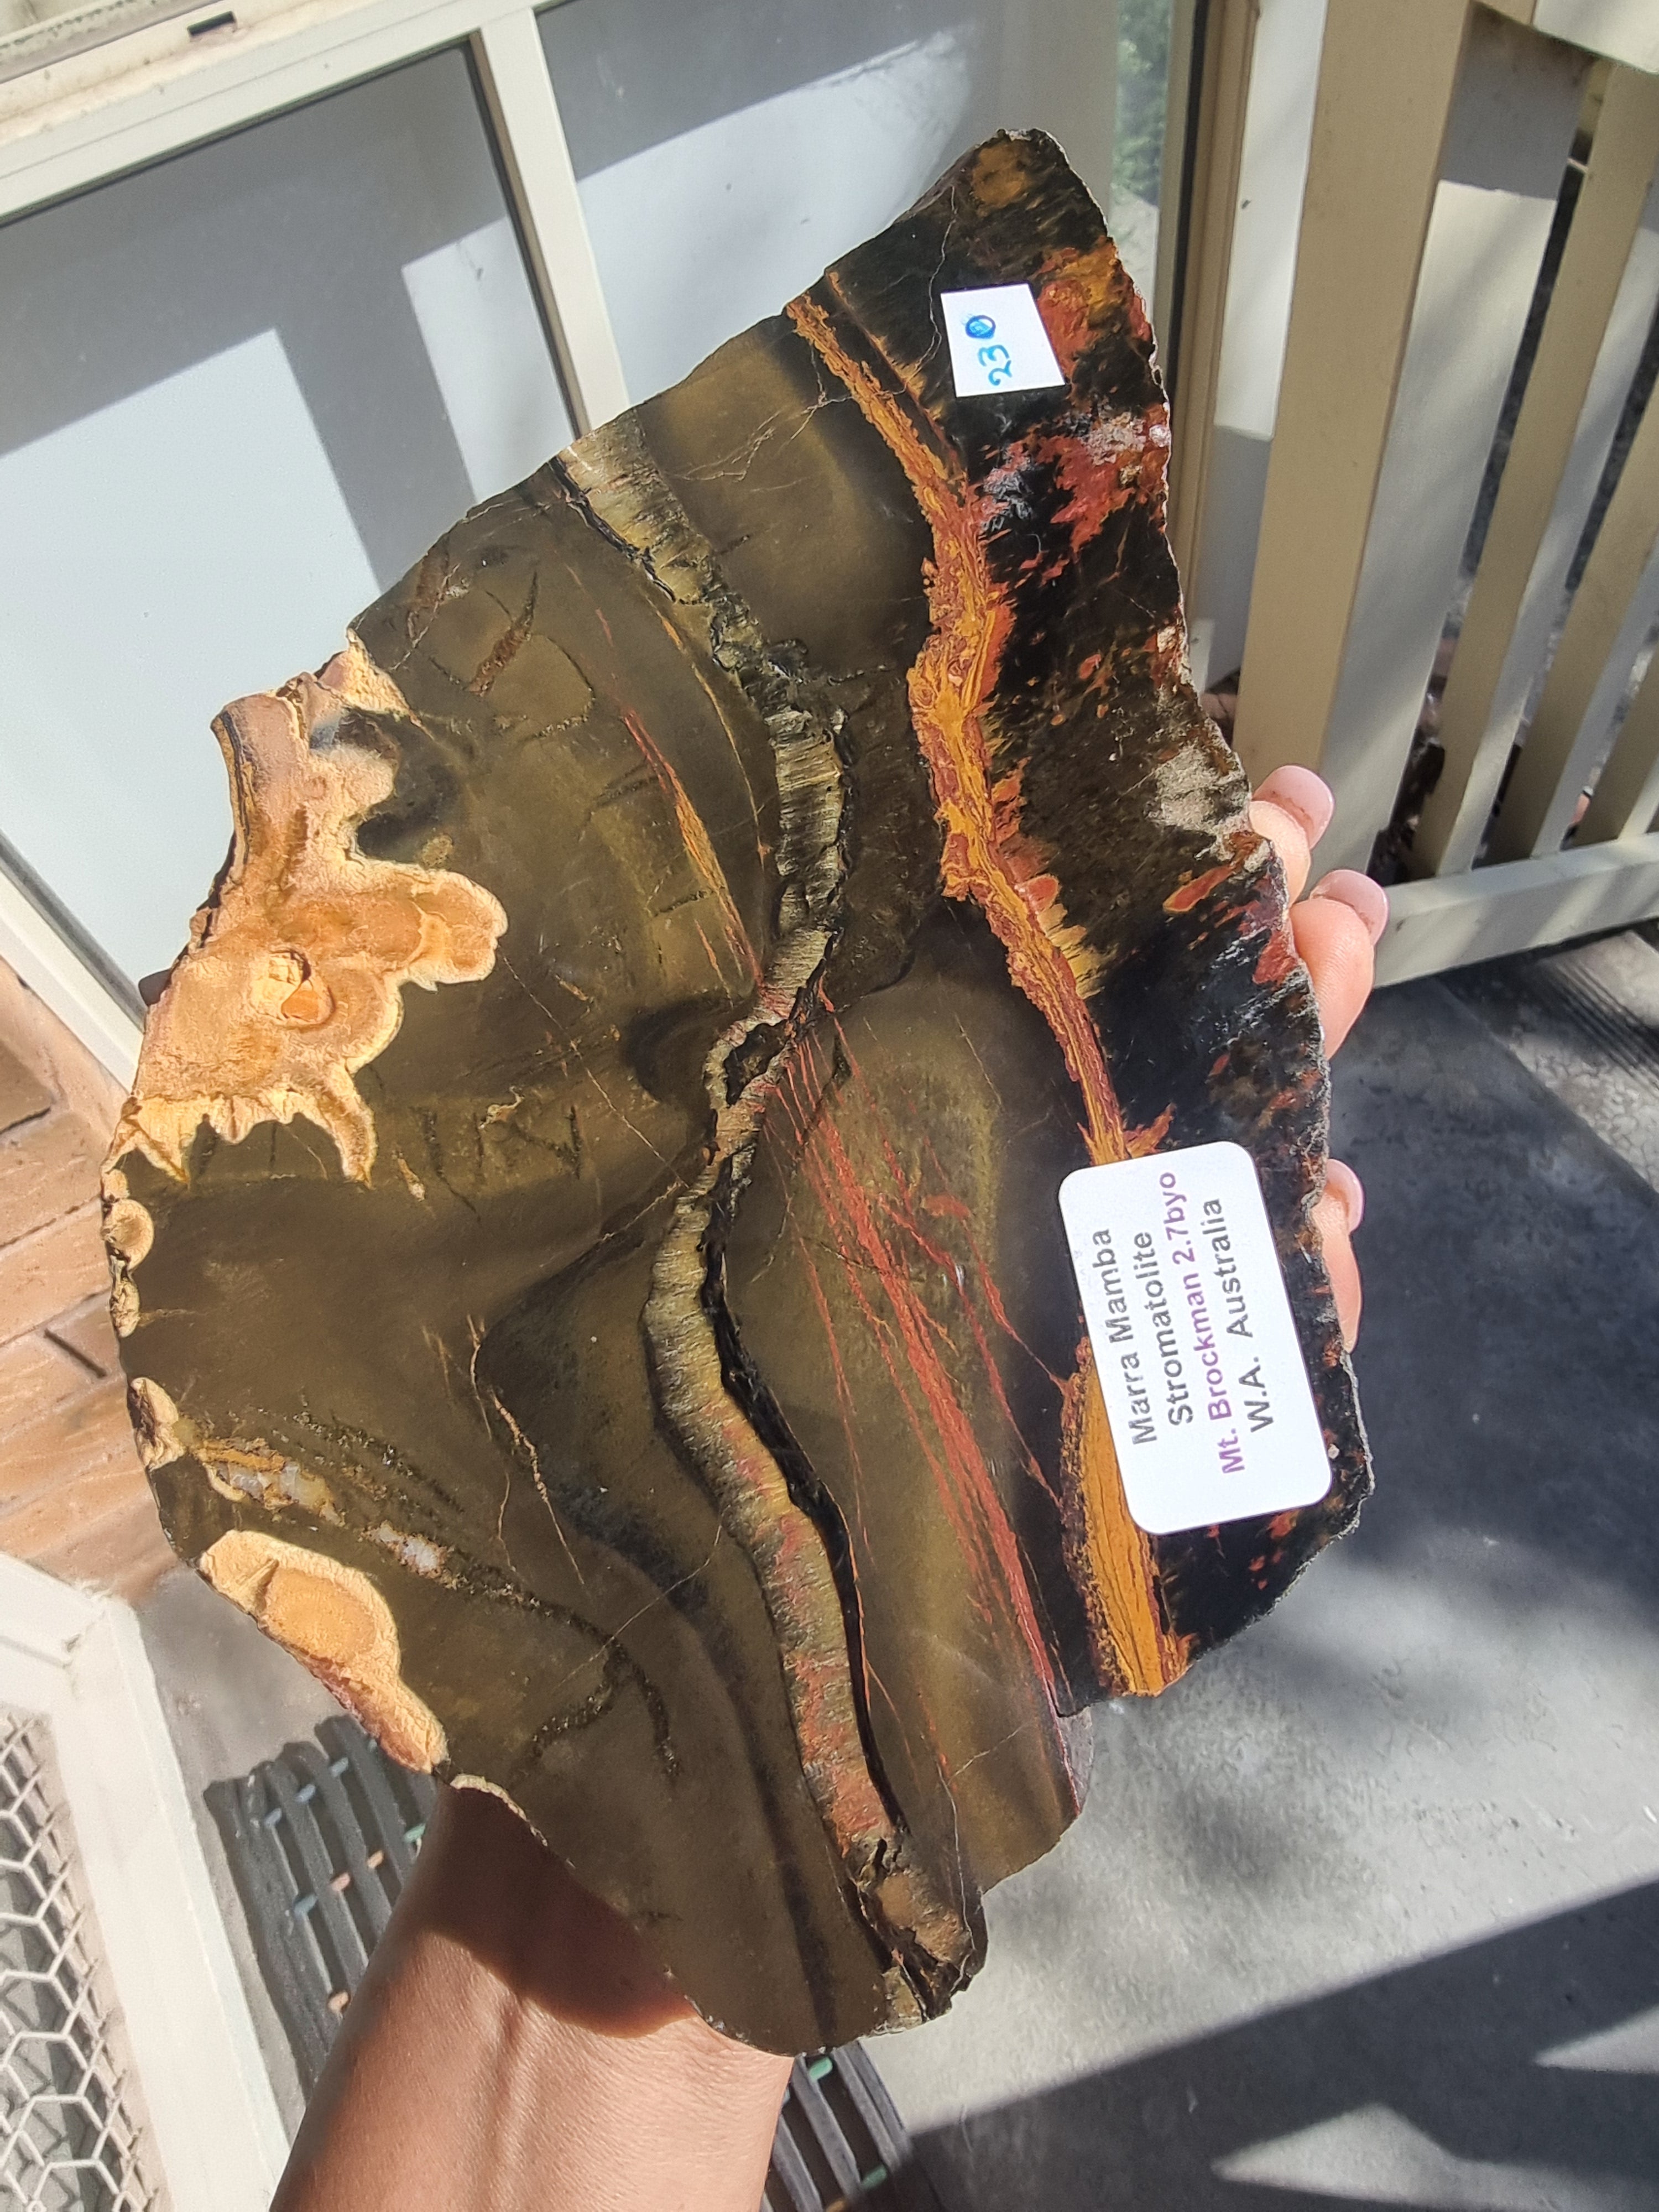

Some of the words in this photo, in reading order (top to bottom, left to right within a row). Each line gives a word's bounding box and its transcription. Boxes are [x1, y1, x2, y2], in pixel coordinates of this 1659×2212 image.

[1160, 1172, 1195, 1265] 2.7byo
[1201, 1199, 1253, 1338] Australia
[1092, 1229, 1134, 1343] Mamba
[1133, 1232, 1193, 1426] Stromatolite
[1120, 1352, 1157, 1444] Marra
[1183, 1273, 1232, 1420] Brockman
[1238, 1357, 1274, 1433] W.A.
[1218, 1429, 1245, 1474] Mt.
